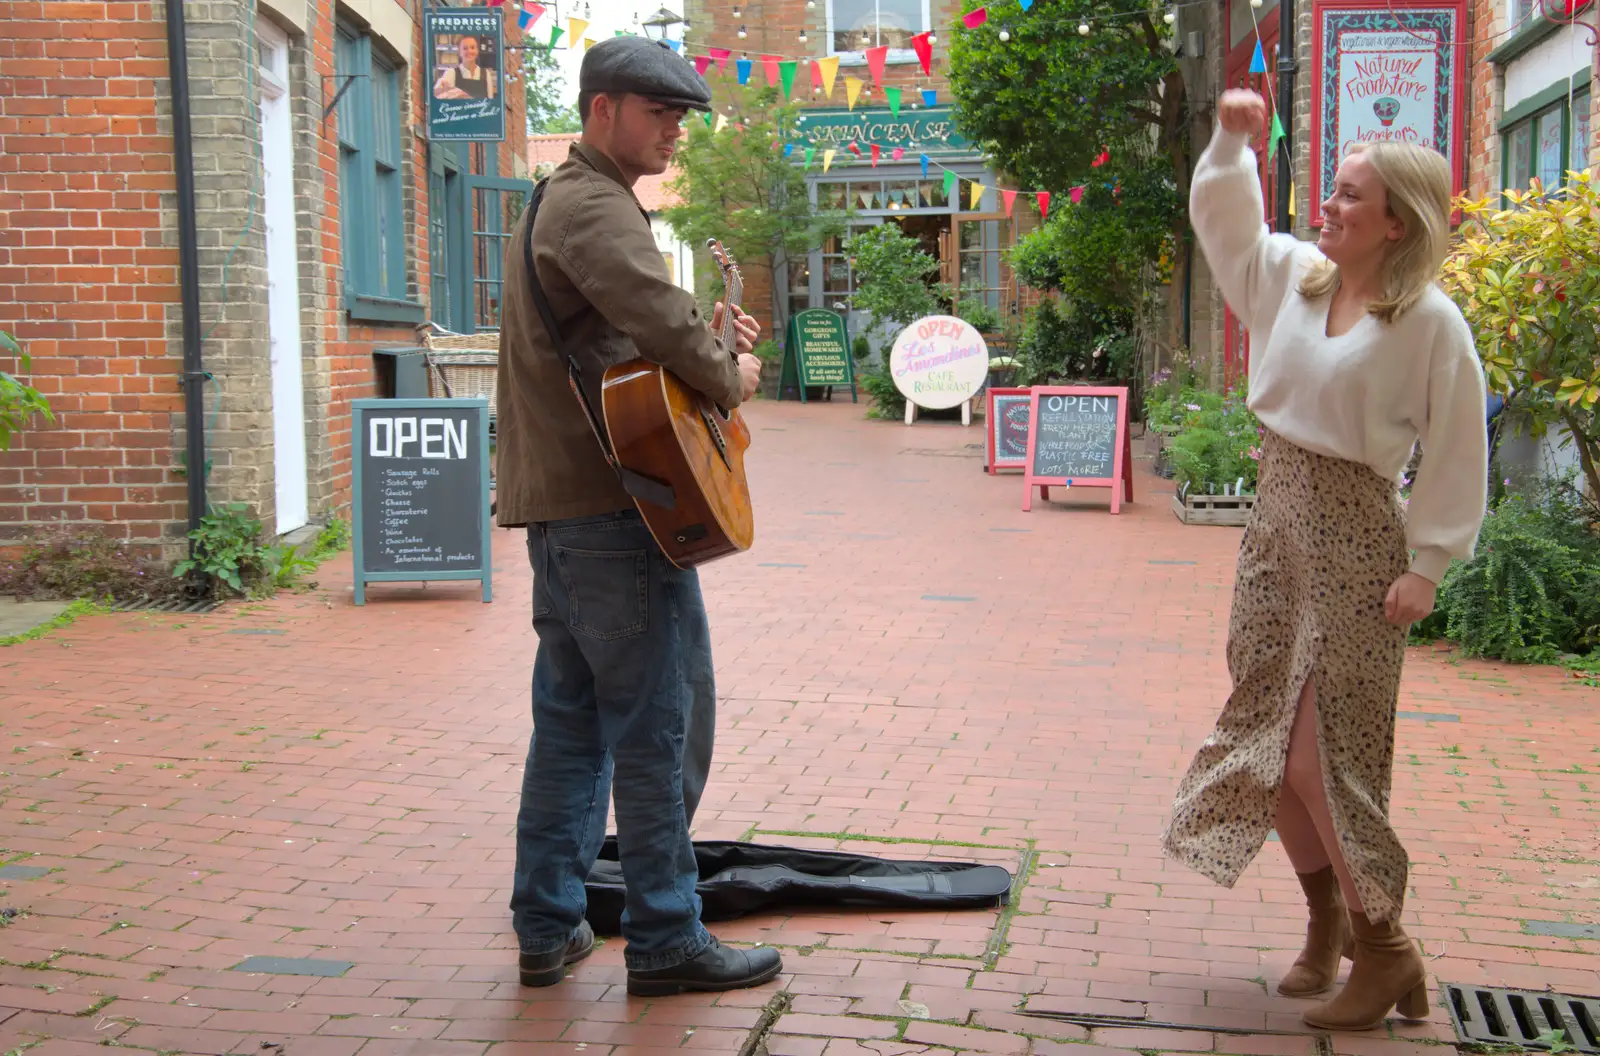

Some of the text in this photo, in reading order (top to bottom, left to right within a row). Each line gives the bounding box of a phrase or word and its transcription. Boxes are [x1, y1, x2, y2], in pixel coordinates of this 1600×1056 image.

[431, 17, 497, 26] FREDRICKS
[1354, 54, 1423, 80] Natural
[1345, 74, 1428, 102] Foodstore
[438, 102, 463, 114] Come
[918, 319, 964, 340] OPEN
[901, 341, 935, 360] Les
[1048, 396, 1109, 413] OPEN
[1006, 405, 1031, 420] NATURA
[1041, 412, 1077, 423] REFILL
[1041, 423, 1069, 432] FRESH
[369, 417, 468, 459] OPEN
[1006, 438, 1027, 453] WORKER
[1039, 450, 1111, 462] PLASTIC FREE
[386, 467, 440, 479] Sausage Rolls
[1041, 465, 1063, 475] LOTS
[412, 480, 428, 489] eggs
[385, 488, 412, 497] Quiches
[385, 499, 412, 507] Cheese
[384, 518, 409, 527] Coffee
[385, 536, 424, 545] Chocolates
[434, 546, 443, 554] of
[394, 552, 475, 564] International products
